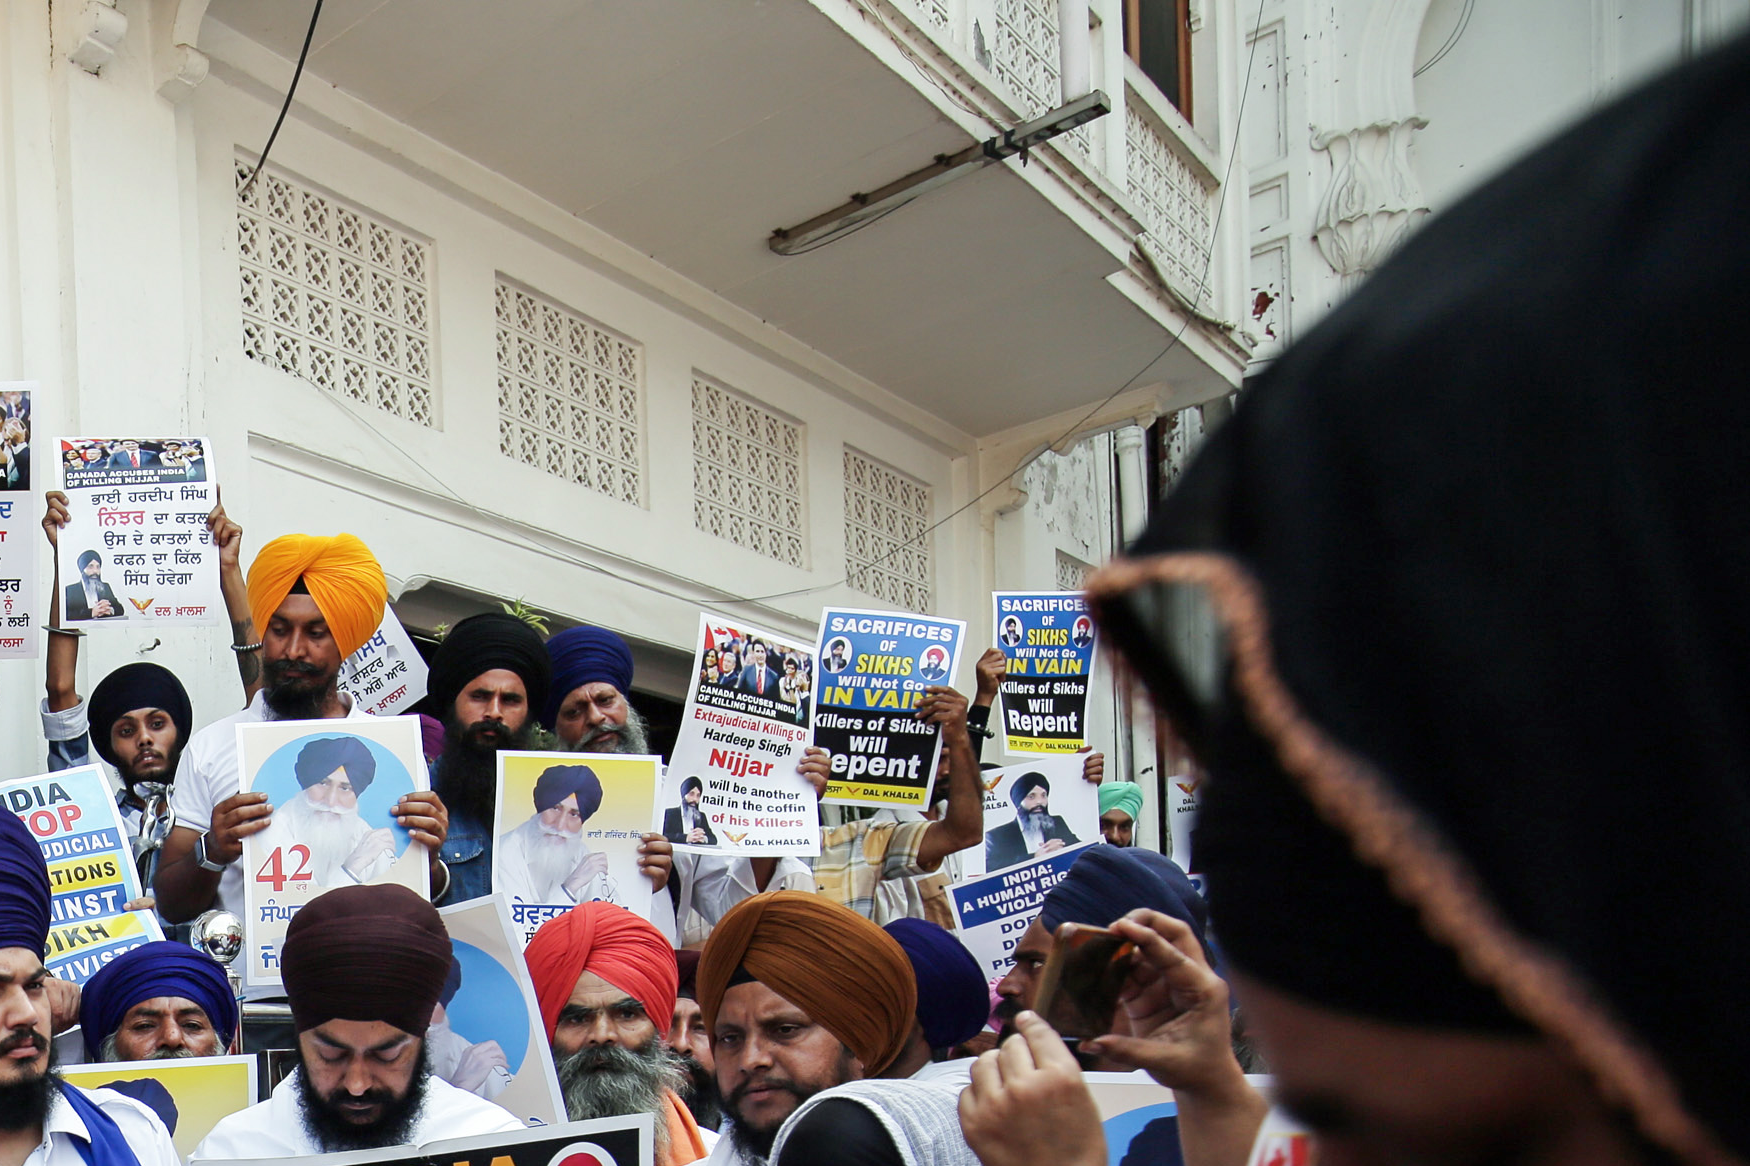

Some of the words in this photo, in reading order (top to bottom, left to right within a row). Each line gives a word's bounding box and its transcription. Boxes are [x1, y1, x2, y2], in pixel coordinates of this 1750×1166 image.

[67, 471, 106, 479] CANADA
[110, 469, 155, 477] ACCUSES
[67, 479, 79, 487] OF
[83, 478, 121, 486] KILLING
[831, 617, 953, 642] SACRIFICES
[1042, 616, 1054, 626] OF
[880, 640, 897, 652] OF
[1027, 629, 1067, 646] SIKHS
[1015, 648, 1036, 657] Will
[1039, 649, 1058, 657] Not
[1062, 649, 1076, 658] Go
[855, 654, 914, 676] SIKHS
[1006, 659, 1027, 673] IN
[1034, 659, 1082, 674] VAIN
[838, 676, 866, 687] Will
[871, 678, 898, 690] Not
[903, 680, 924, 691] Go
[1001, 682, 1035, 694] Killers
[1038, 682, 1049, 694] of
[1053, 683, 1084, 694] Sikhs
[700, 685, 735, 700] CANADA
[737, 693, 774, 708] ACCUSES
[775, 702, 795, 715] INDIA
[823, 687, 854, 705] IN
[698, 694, 710, 702] OF
[711, 696, 746, 713] KILLING
[748, 704, 776, 718] NIJJAR
[1028, 699, 1053, 713] Will
[694, 708, 760, 731] Extrajudicial
[762, 723, 794, 741] Killing
[796, 731, 806, 741] Of
[867, 717, 885, 731] of
[889, 718, 935, 735] Sikhs
[1008, 710, 1077, 736] Repent
[704, 728, 755, 749] Hardeep
[758, 739, 792, 756] Singh
[850, 736, 888, 754] Will
[709, 749, 774, 777] Nijjar
[710, 779, 729, 791] will
[733, 783, 747, 794] be
[751, 786, 801, 800] another
[883, 790, 919, 800] KHALSA
[703, 794, 724, 805] nail
[728, 798, 739, 808] in
[743, 800, 762, 812] the
[767, 802, 806, 813] coffin
[712, 813, 726, 824] of
[729, 814, 750, 826] his
[755, 813, 803, 828] Killers
[256, 844, 312, 891] 42
